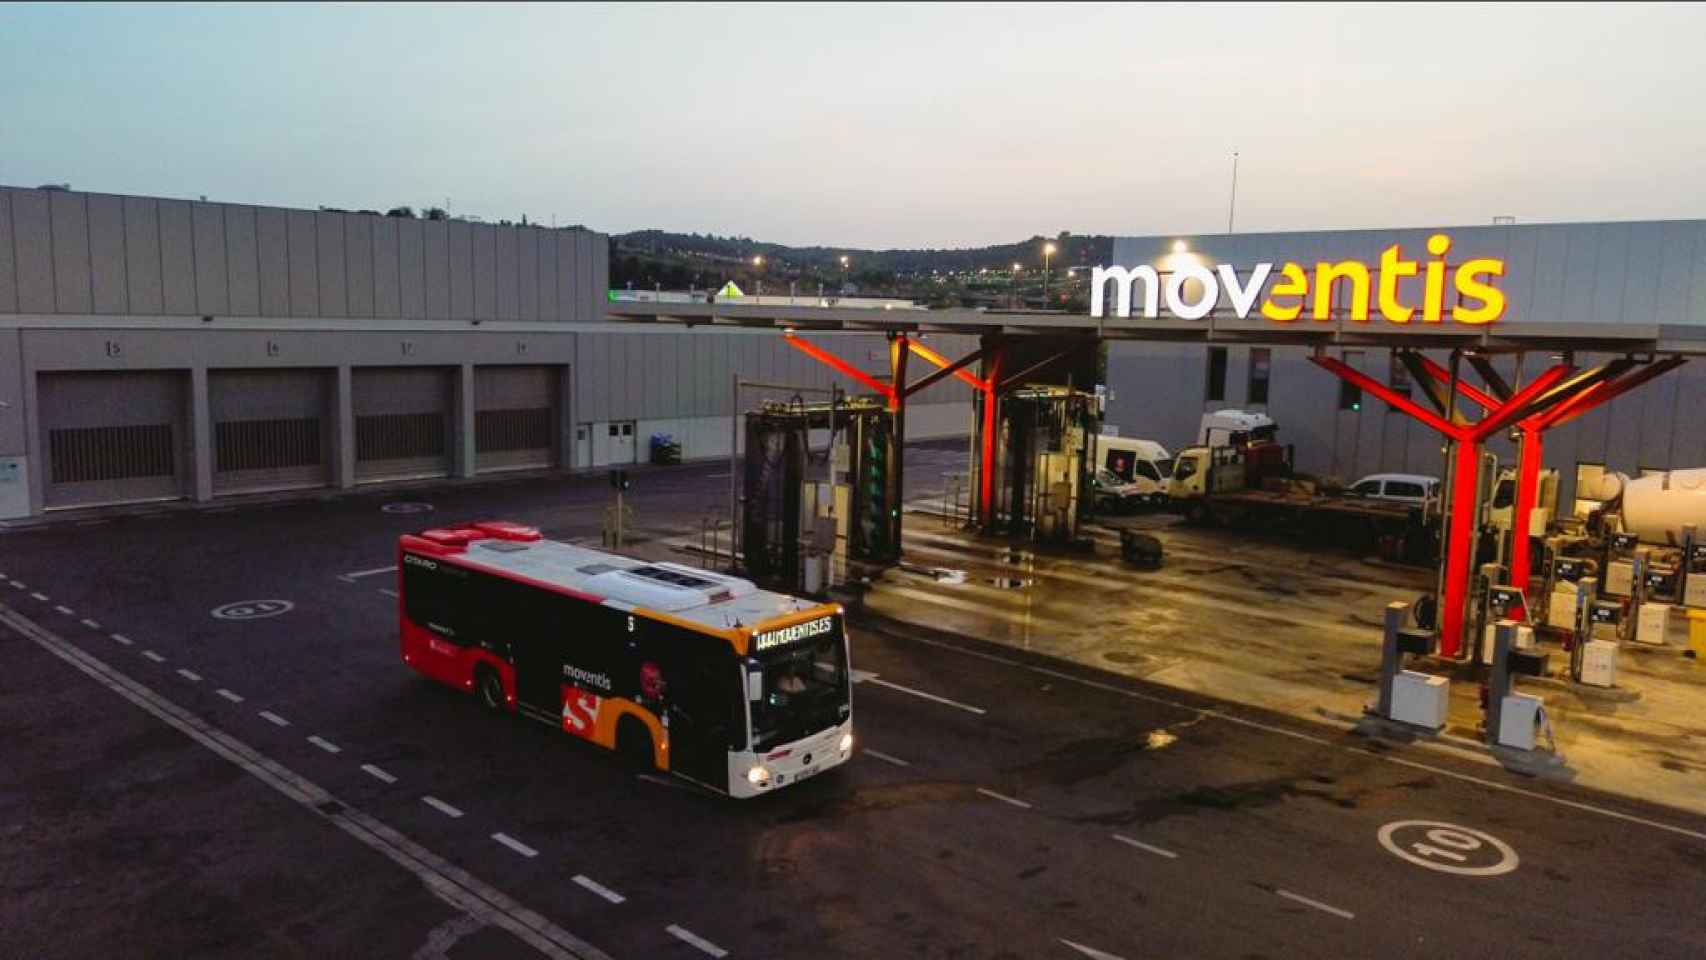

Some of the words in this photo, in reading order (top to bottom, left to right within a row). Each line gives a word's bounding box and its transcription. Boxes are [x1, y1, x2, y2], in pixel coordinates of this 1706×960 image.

[1090, 234, 1507, 324] moventis
[563, 664, 611, 690] moventis
[1412, 829, 1482, 861] 10
